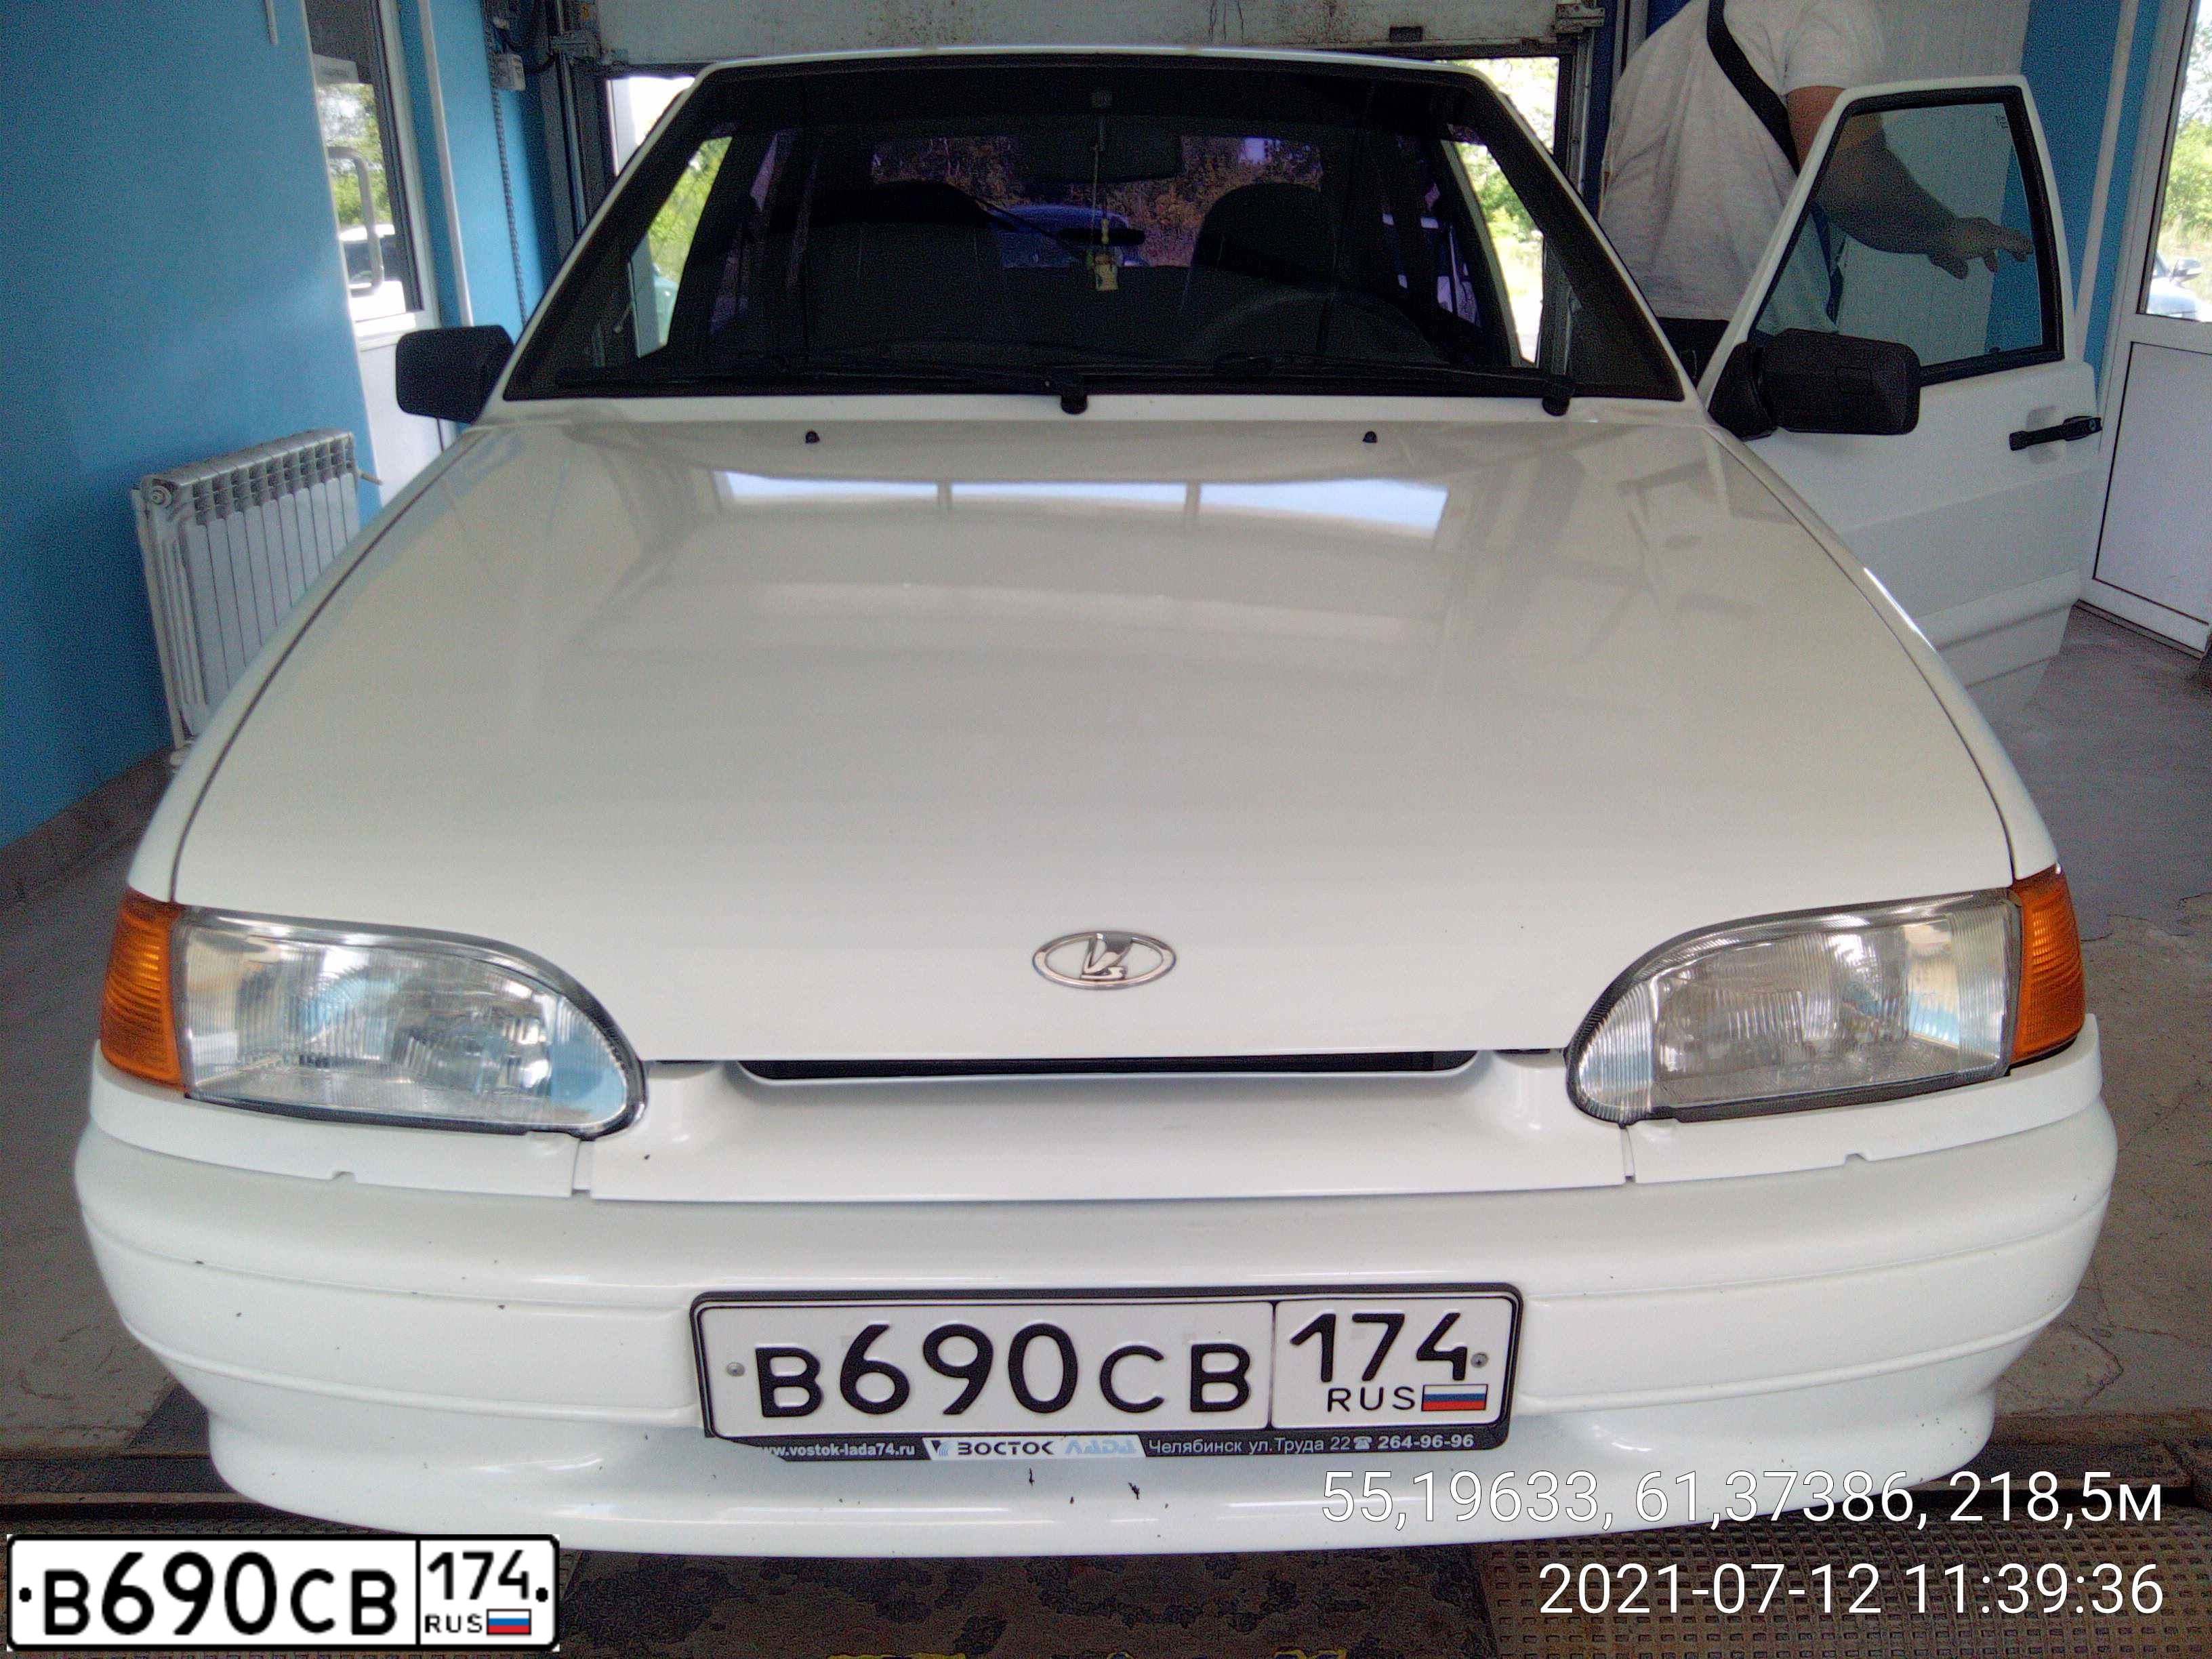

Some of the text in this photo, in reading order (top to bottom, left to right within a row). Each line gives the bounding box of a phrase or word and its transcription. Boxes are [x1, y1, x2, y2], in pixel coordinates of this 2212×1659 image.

[755, 1312, 1469, 1418] В690СВ 174
[1327, 1386, 1416, 1412] RUS
[1148, 1438, 1242, 1454] Челябинск
[1330, 1435, 1351, 1450] 22
[1377, 1433, 1475, 1450] 264-96-96
